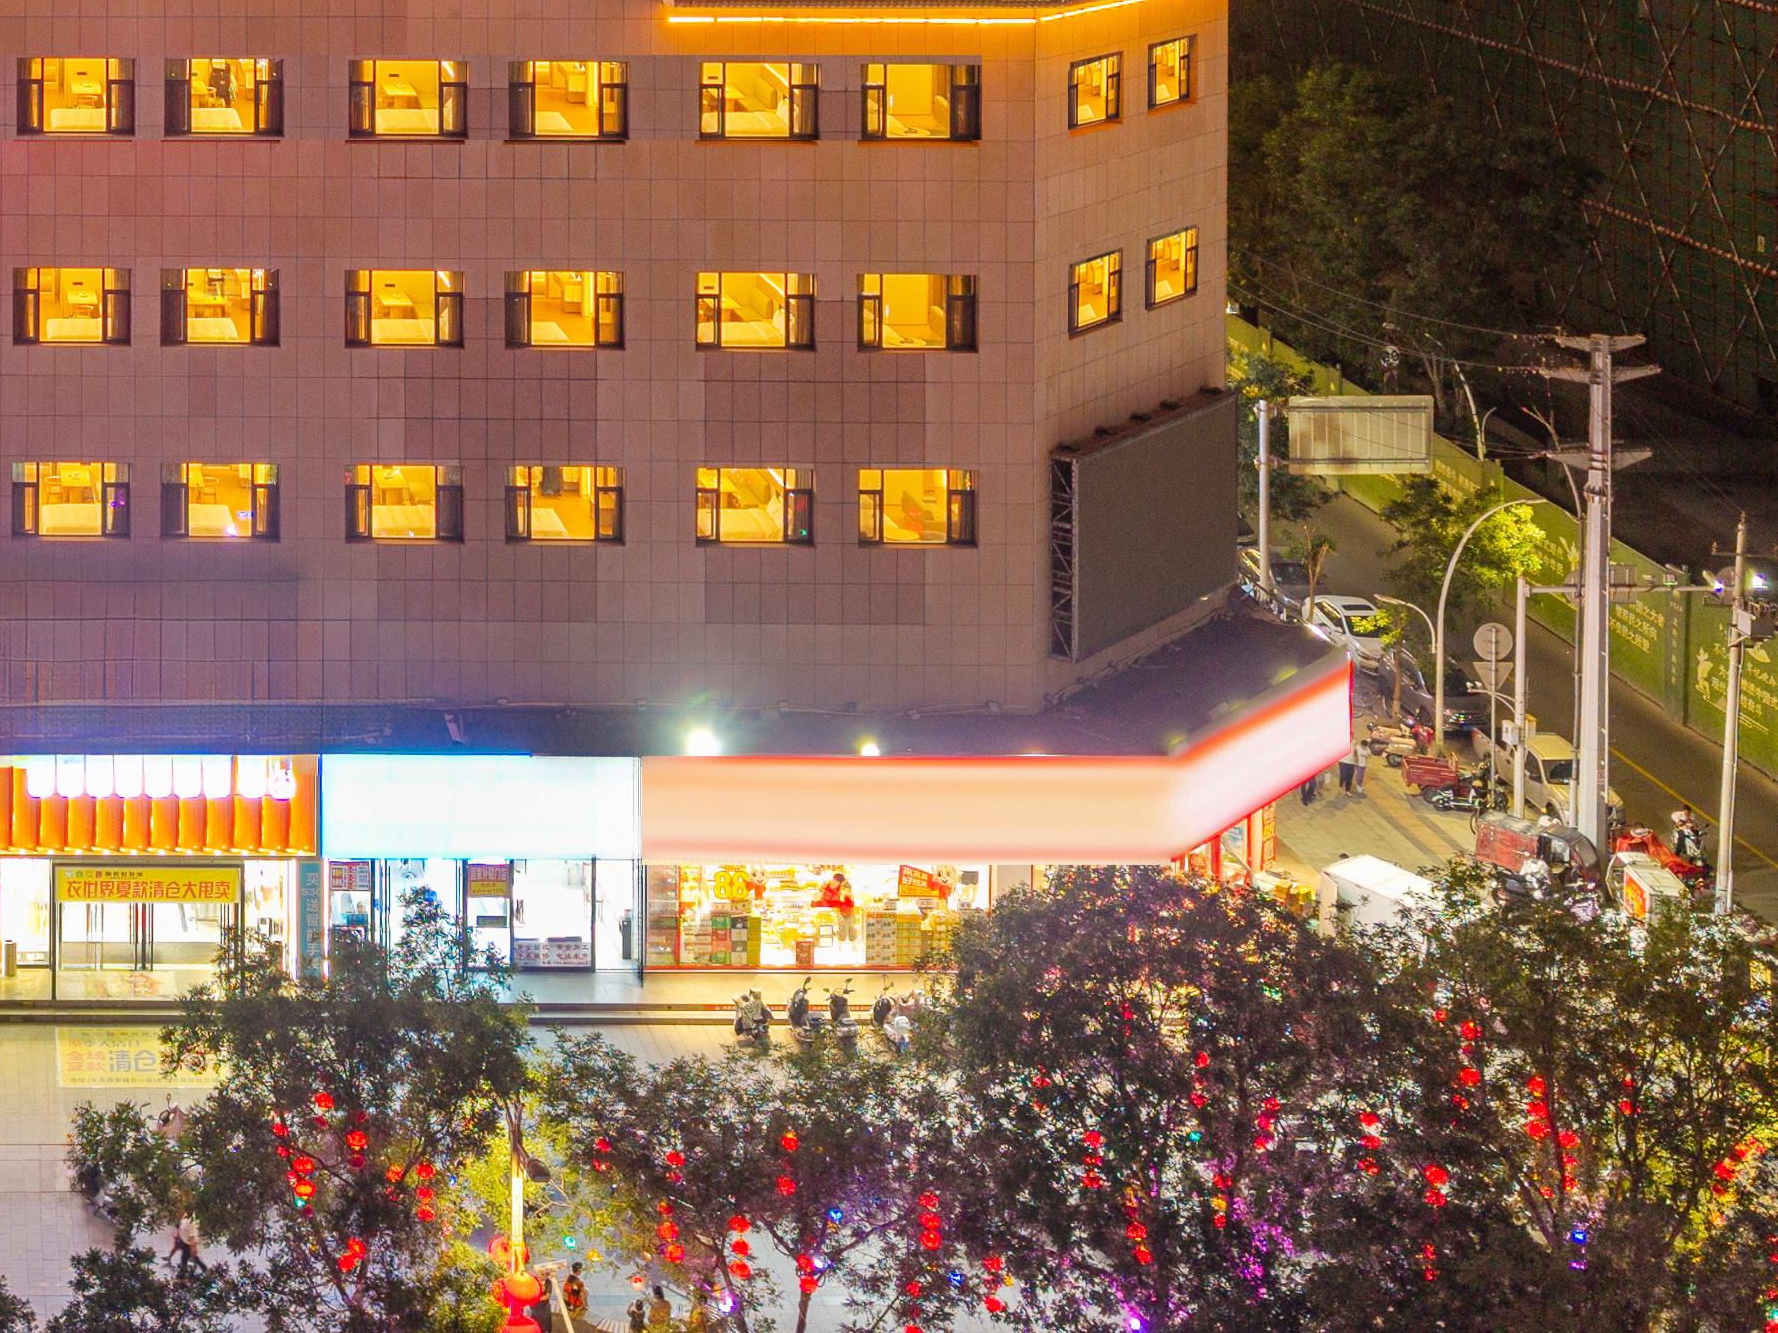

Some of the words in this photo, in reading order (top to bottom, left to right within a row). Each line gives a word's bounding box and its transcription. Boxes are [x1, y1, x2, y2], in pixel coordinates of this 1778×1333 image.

[66, 880, 231, 900] 衣世界夏款清仓大甩卖
